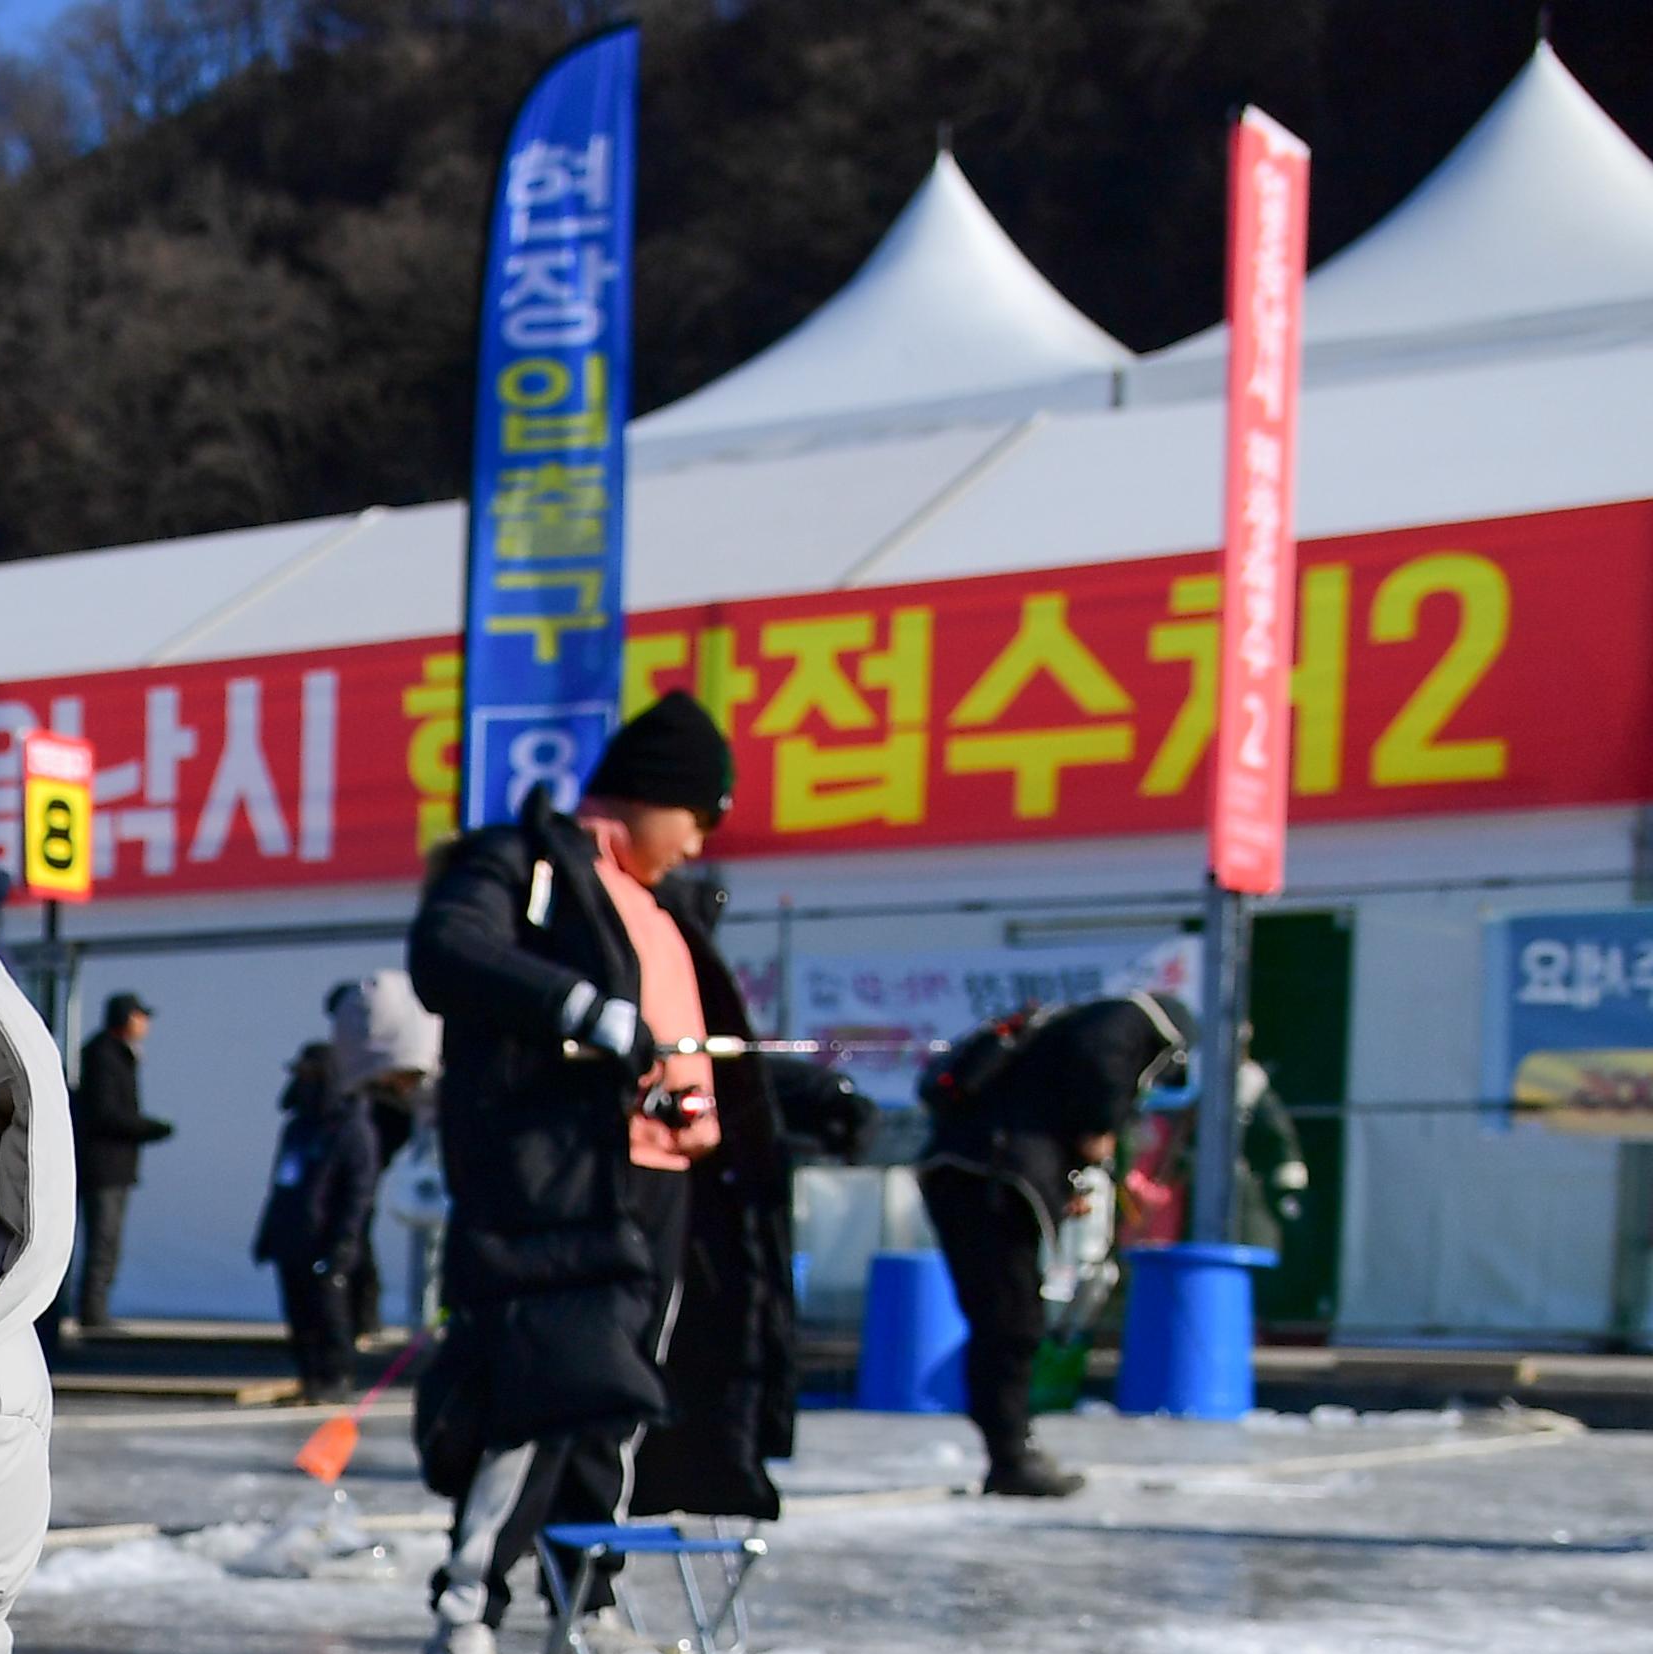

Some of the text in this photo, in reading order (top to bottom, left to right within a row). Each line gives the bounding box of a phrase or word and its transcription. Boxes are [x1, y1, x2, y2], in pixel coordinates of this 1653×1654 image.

[485, 133, 620, 662] 현장입출구
[508, 729, 580, 816] 8
[43, 799, 73, 869] 8
